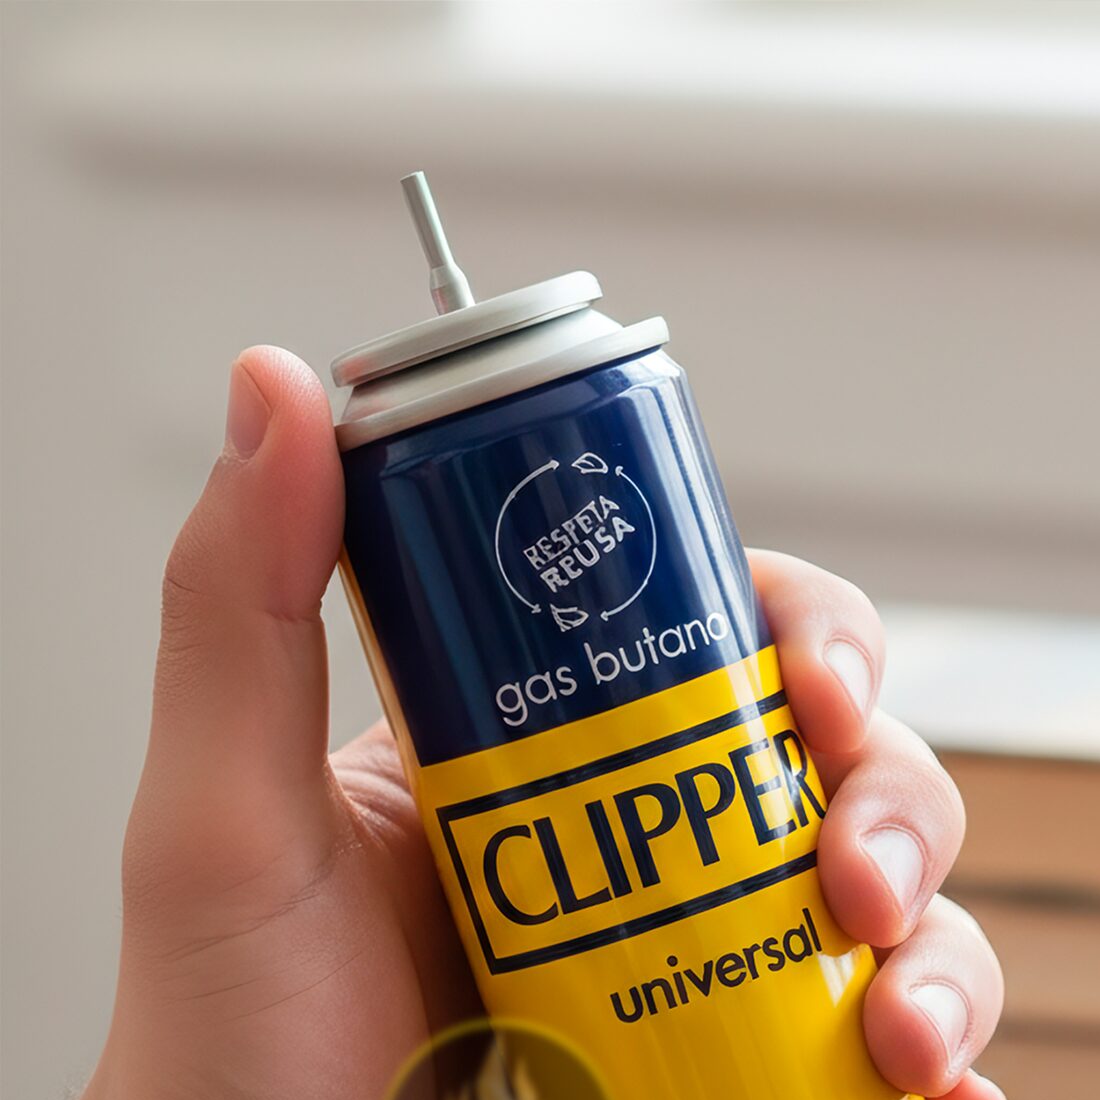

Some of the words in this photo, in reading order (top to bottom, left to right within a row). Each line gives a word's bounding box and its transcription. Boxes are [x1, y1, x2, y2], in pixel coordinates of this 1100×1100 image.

[523, 495, 620, 571] RESPETA
[540, 516, 635, 592] REUSA
[495, 666, 578, 727] gas
[583, 612, 730, 686] butano
[482, 729, 827, 926] CLIPPER
[609, 907, 823, 1024] universal
